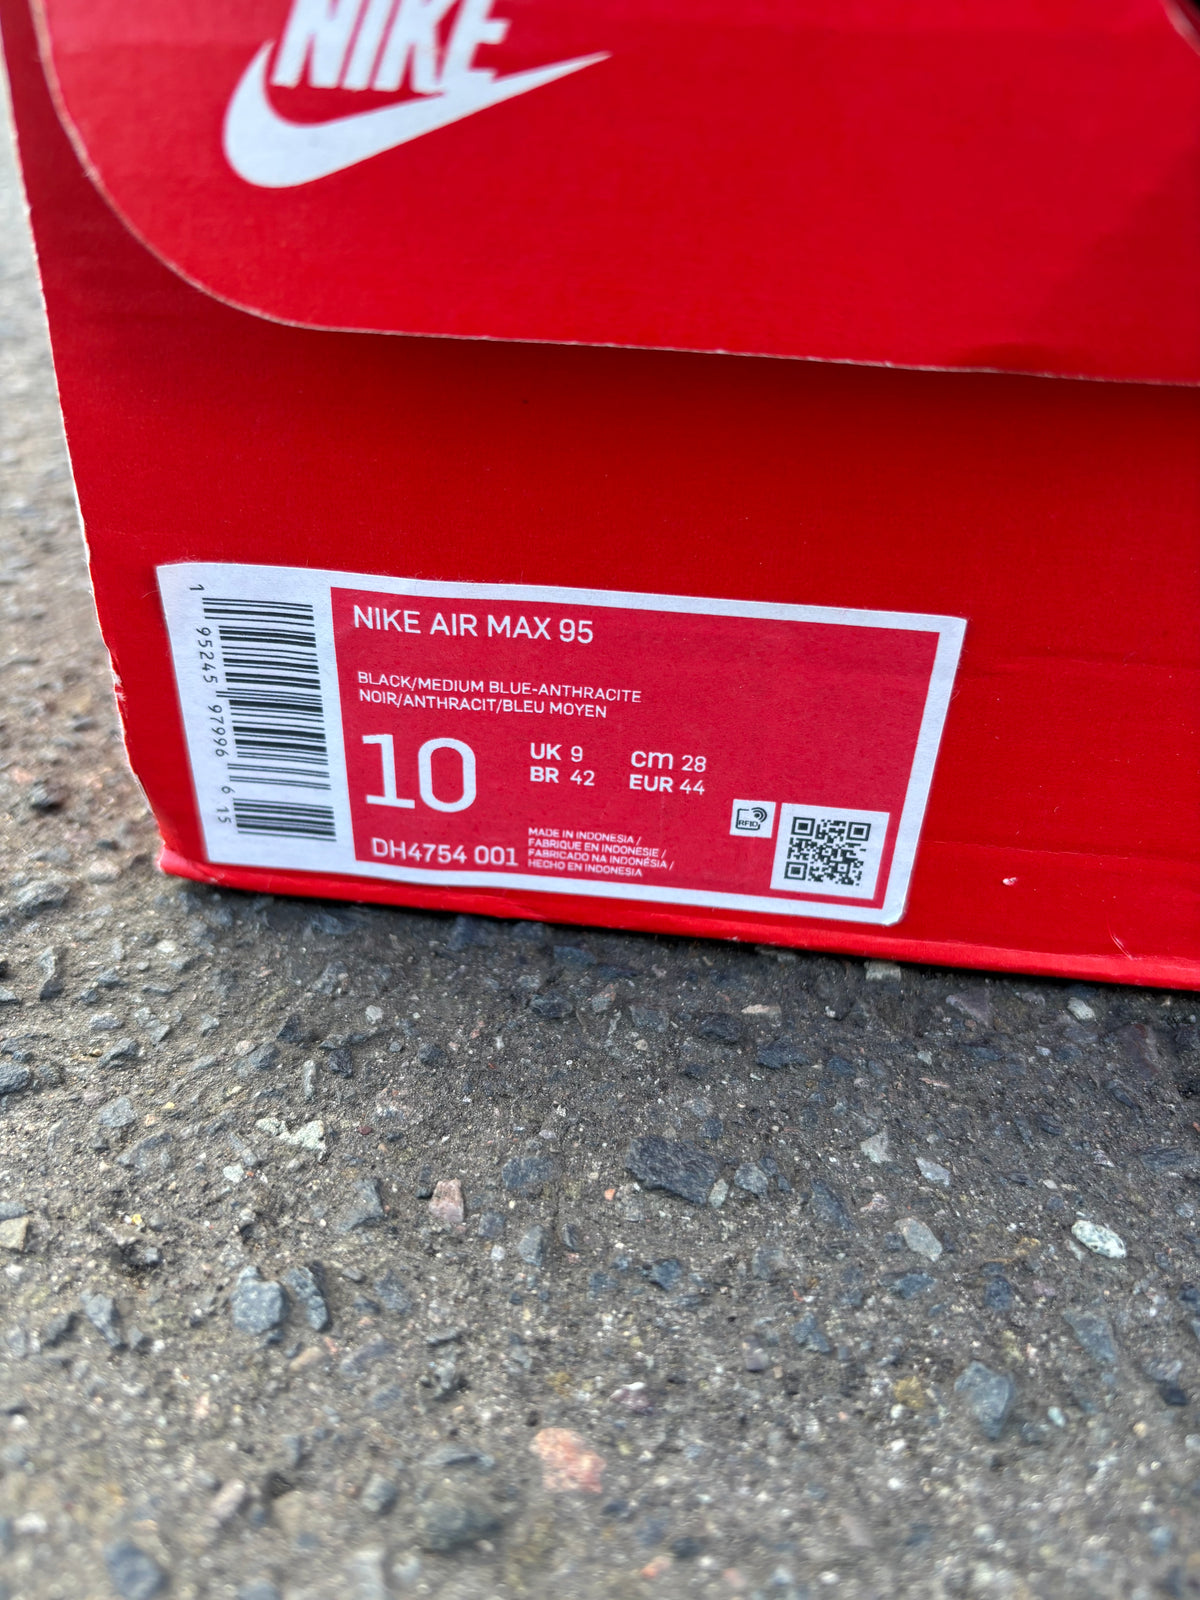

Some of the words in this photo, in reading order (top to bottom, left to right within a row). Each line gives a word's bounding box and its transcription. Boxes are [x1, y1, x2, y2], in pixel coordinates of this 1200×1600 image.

[271, 0, 511, 94] NIKE
[353, 604, 421, 635] NIKE
[429, 612, 478, 637] AIR
[487, 615, 552, 640] MAX
[558, 618, 594, 645] 95
[196, 627, 218, 683] 95245
[357, 671, 484, 693] BLACK/MEDIUM
[489, 681, 642, 703] BLUE-ANTHRACITE
[359, 688, 545, 713] NOIR/ANTHRACIT/BLEU
[550, 702, 607, 719] MOYEN
[208, 704, 229, 757] 97996
[530, 743, 562, 761] UK
[570, 746, 584, 763] 9
[630, 750, 674, 770] cm
[681, 755, 707, 773] 28
[362, 733, 477, 813] 10
[529, 766, 560, 784] BR
[570, 769, 596, 787] 42
[221, 785, 236, 794] 6
[629, 774, 673, 793] EUR
[679, 779, 706, 796] 44
[216, 806, 232, 824] 15
[738, 819, 758, 827] RFID
[528, 827, 560, 838] MADE
[562, 830, 574, 839] IN
[576, 831, 634, 844] INDONESIA
[528, 838, 582, 850] FABRIQUE
[584, 842, 599, 852] EN
[371, 837, 468, 865] DH4754
[474, 845, 519, 867] 001
[528, 848, 590, 862] FABRICADO
[591, 853, 607, 863] NA
[528, 858, 566, 871] HECHO
[567, 861, 583, 872] EN
[585, 863, 643, 877] INDONESIA
